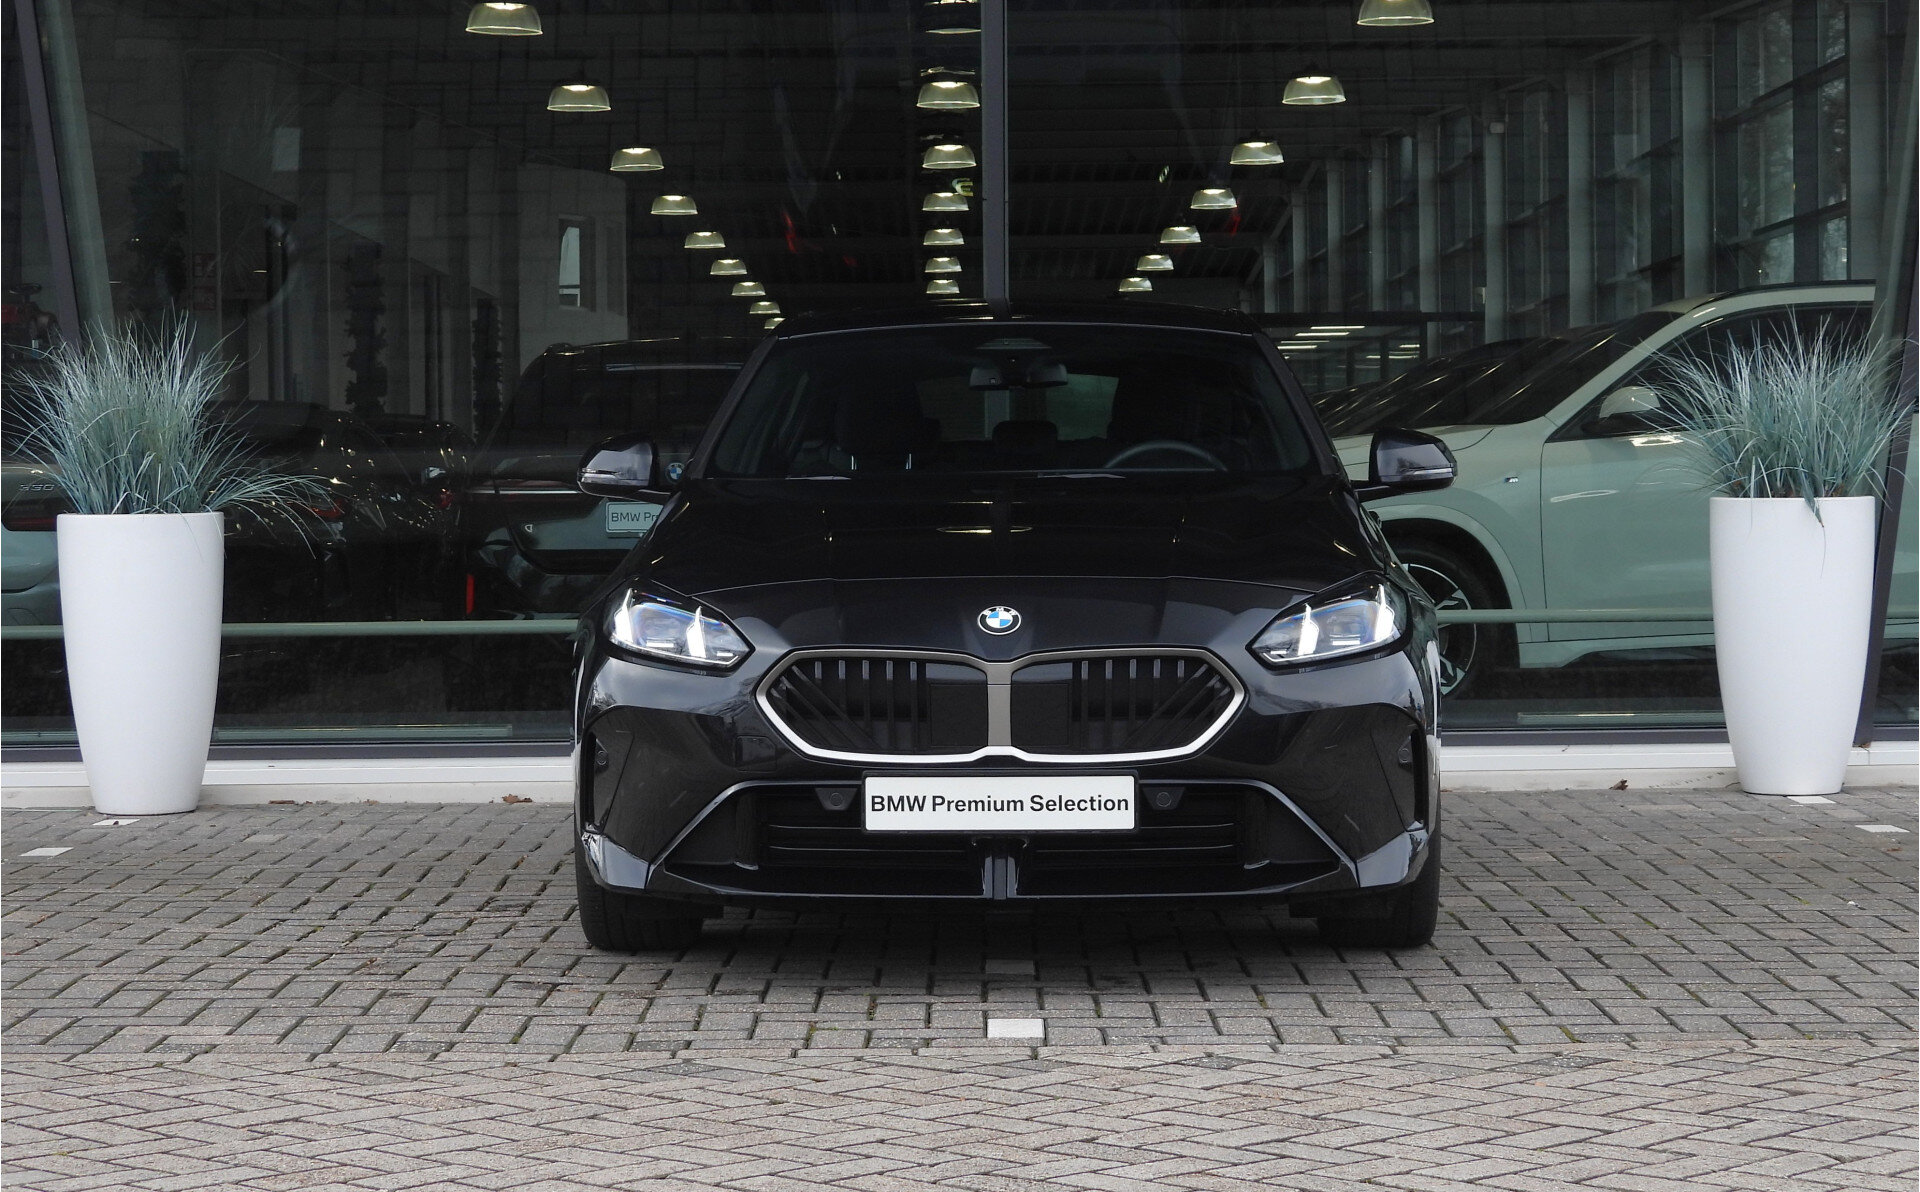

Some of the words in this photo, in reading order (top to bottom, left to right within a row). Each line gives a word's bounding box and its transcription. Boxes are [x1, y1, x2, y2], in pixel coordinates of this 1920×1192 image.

[611, 512, 641, 522] BMW
[871, 795, 927, 812] BMW
[932, 795, 1024, 812] Premium
[1029, 794, 1129, 811] Selection
